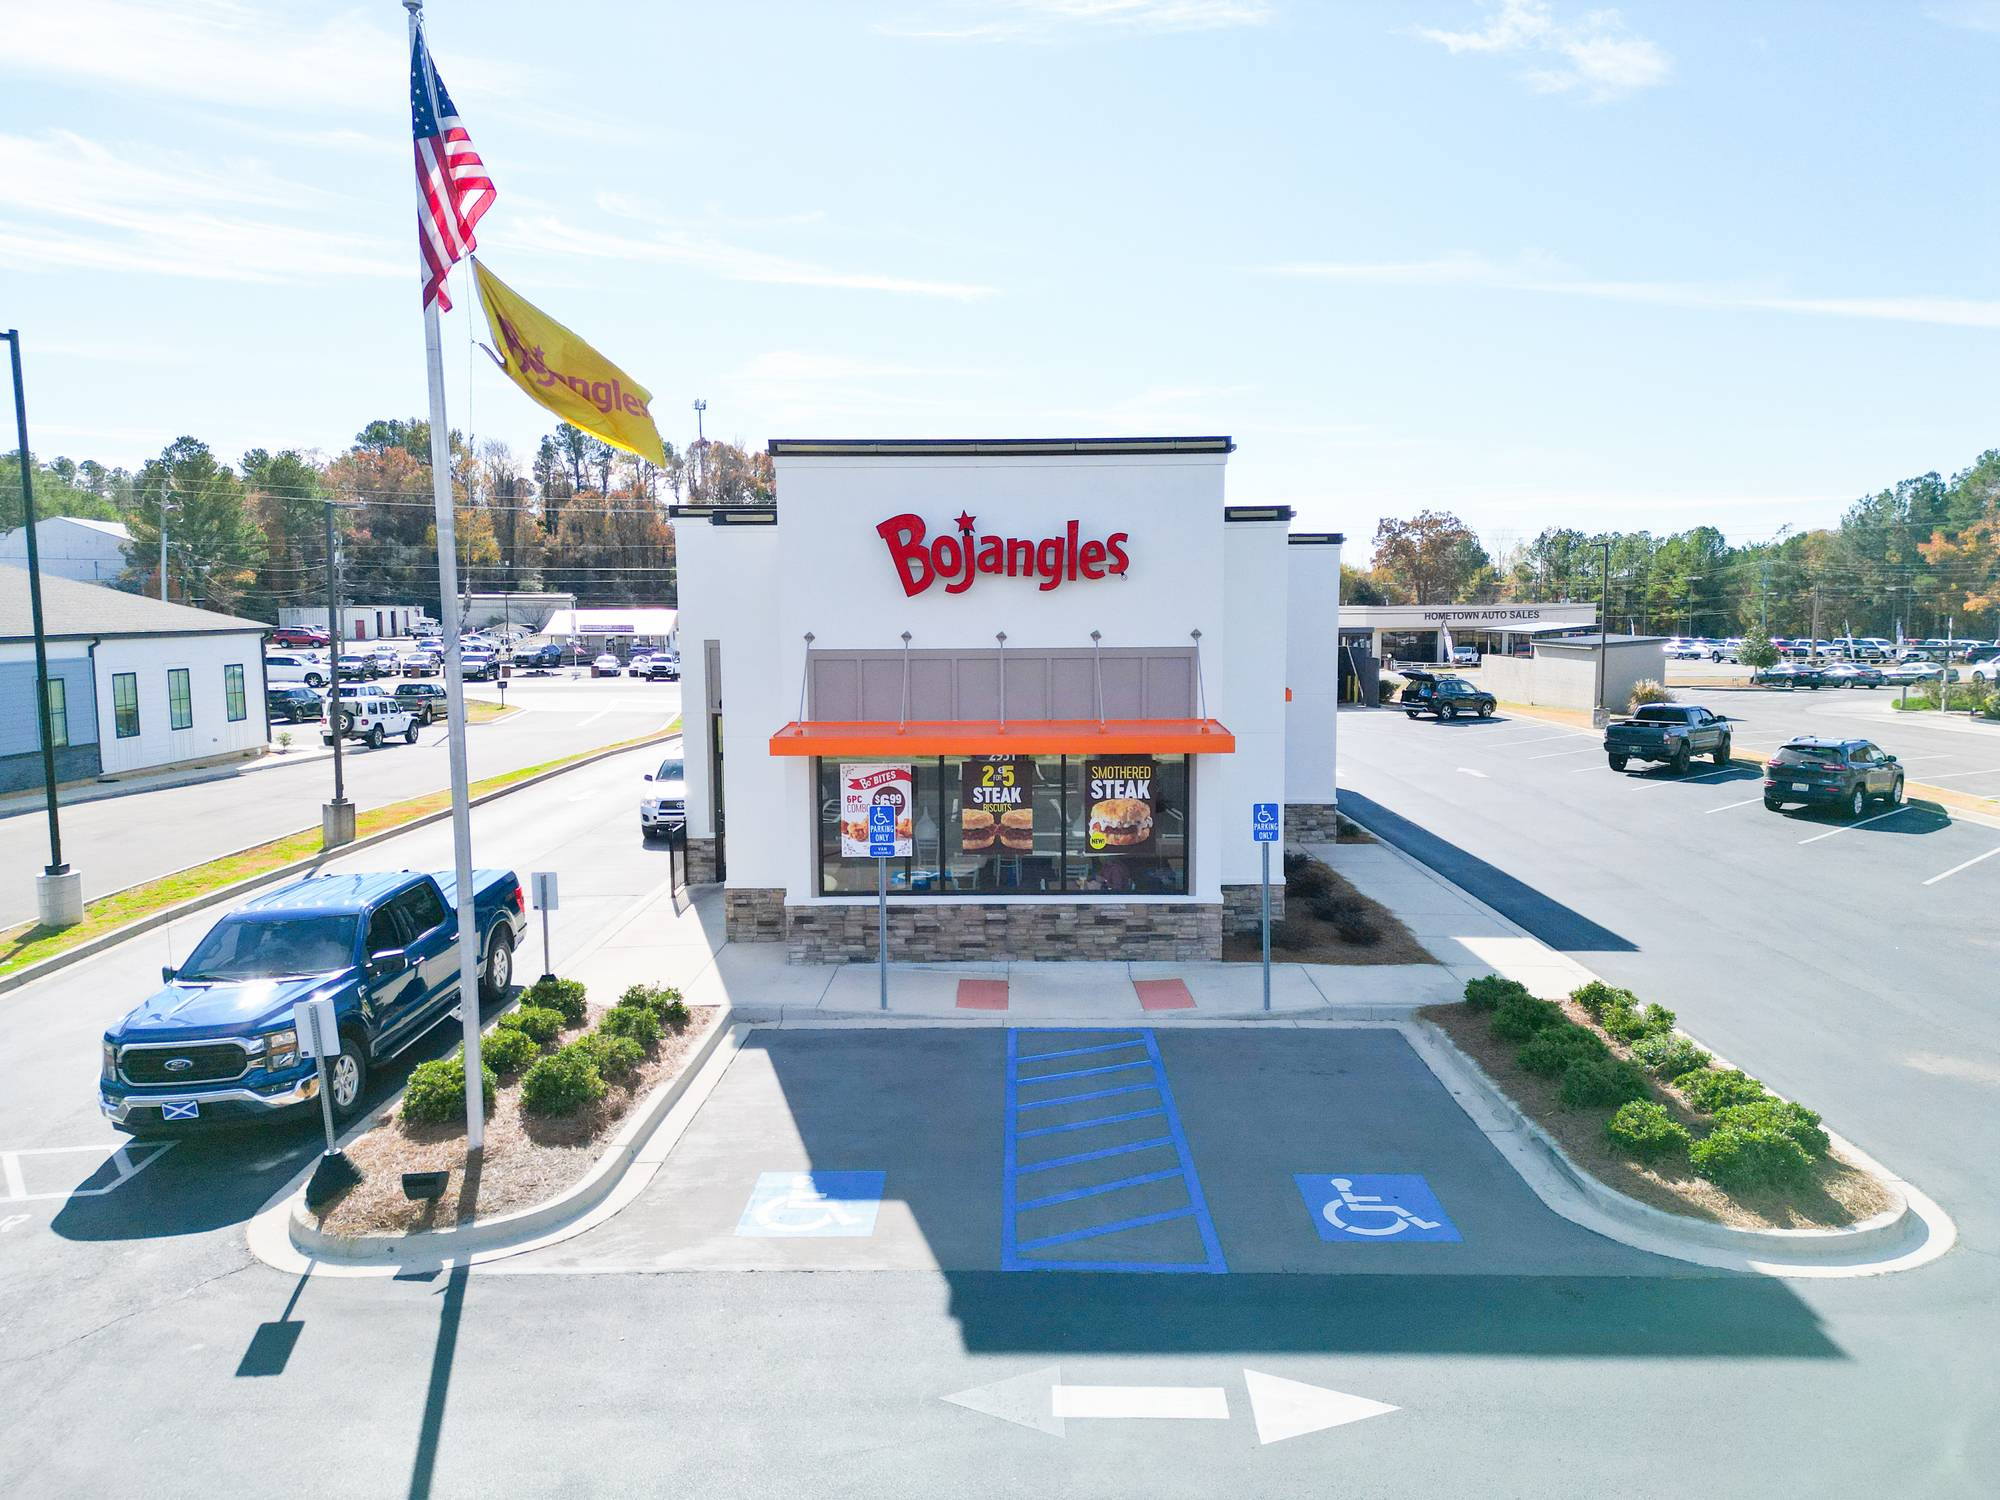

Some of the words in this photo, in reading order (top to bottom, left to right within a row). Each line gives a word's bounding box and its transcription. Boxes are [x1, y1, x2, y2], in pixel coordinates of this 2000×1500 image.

[876, 510, 1130, 598] Bojangles
[1424, 611, 1479, 620] HOMETOWN
[1481, 610, 1507, 619] AUTO
[1509, 610, 1540, 619] SALES
[873, 770, 896, 785] BITES
[982, 765, 995, 787] 2
[1091, 765, 1151, 779] SMOTHERED
[973, 787, 1022, 803] STEAK
[1090, 779, 1151, 799] STEAK
[846, 795, 863, 803] 6PC
[983, 803, 1012, 813] BISCUITS
[875, 834, 889, 842] ONLY
